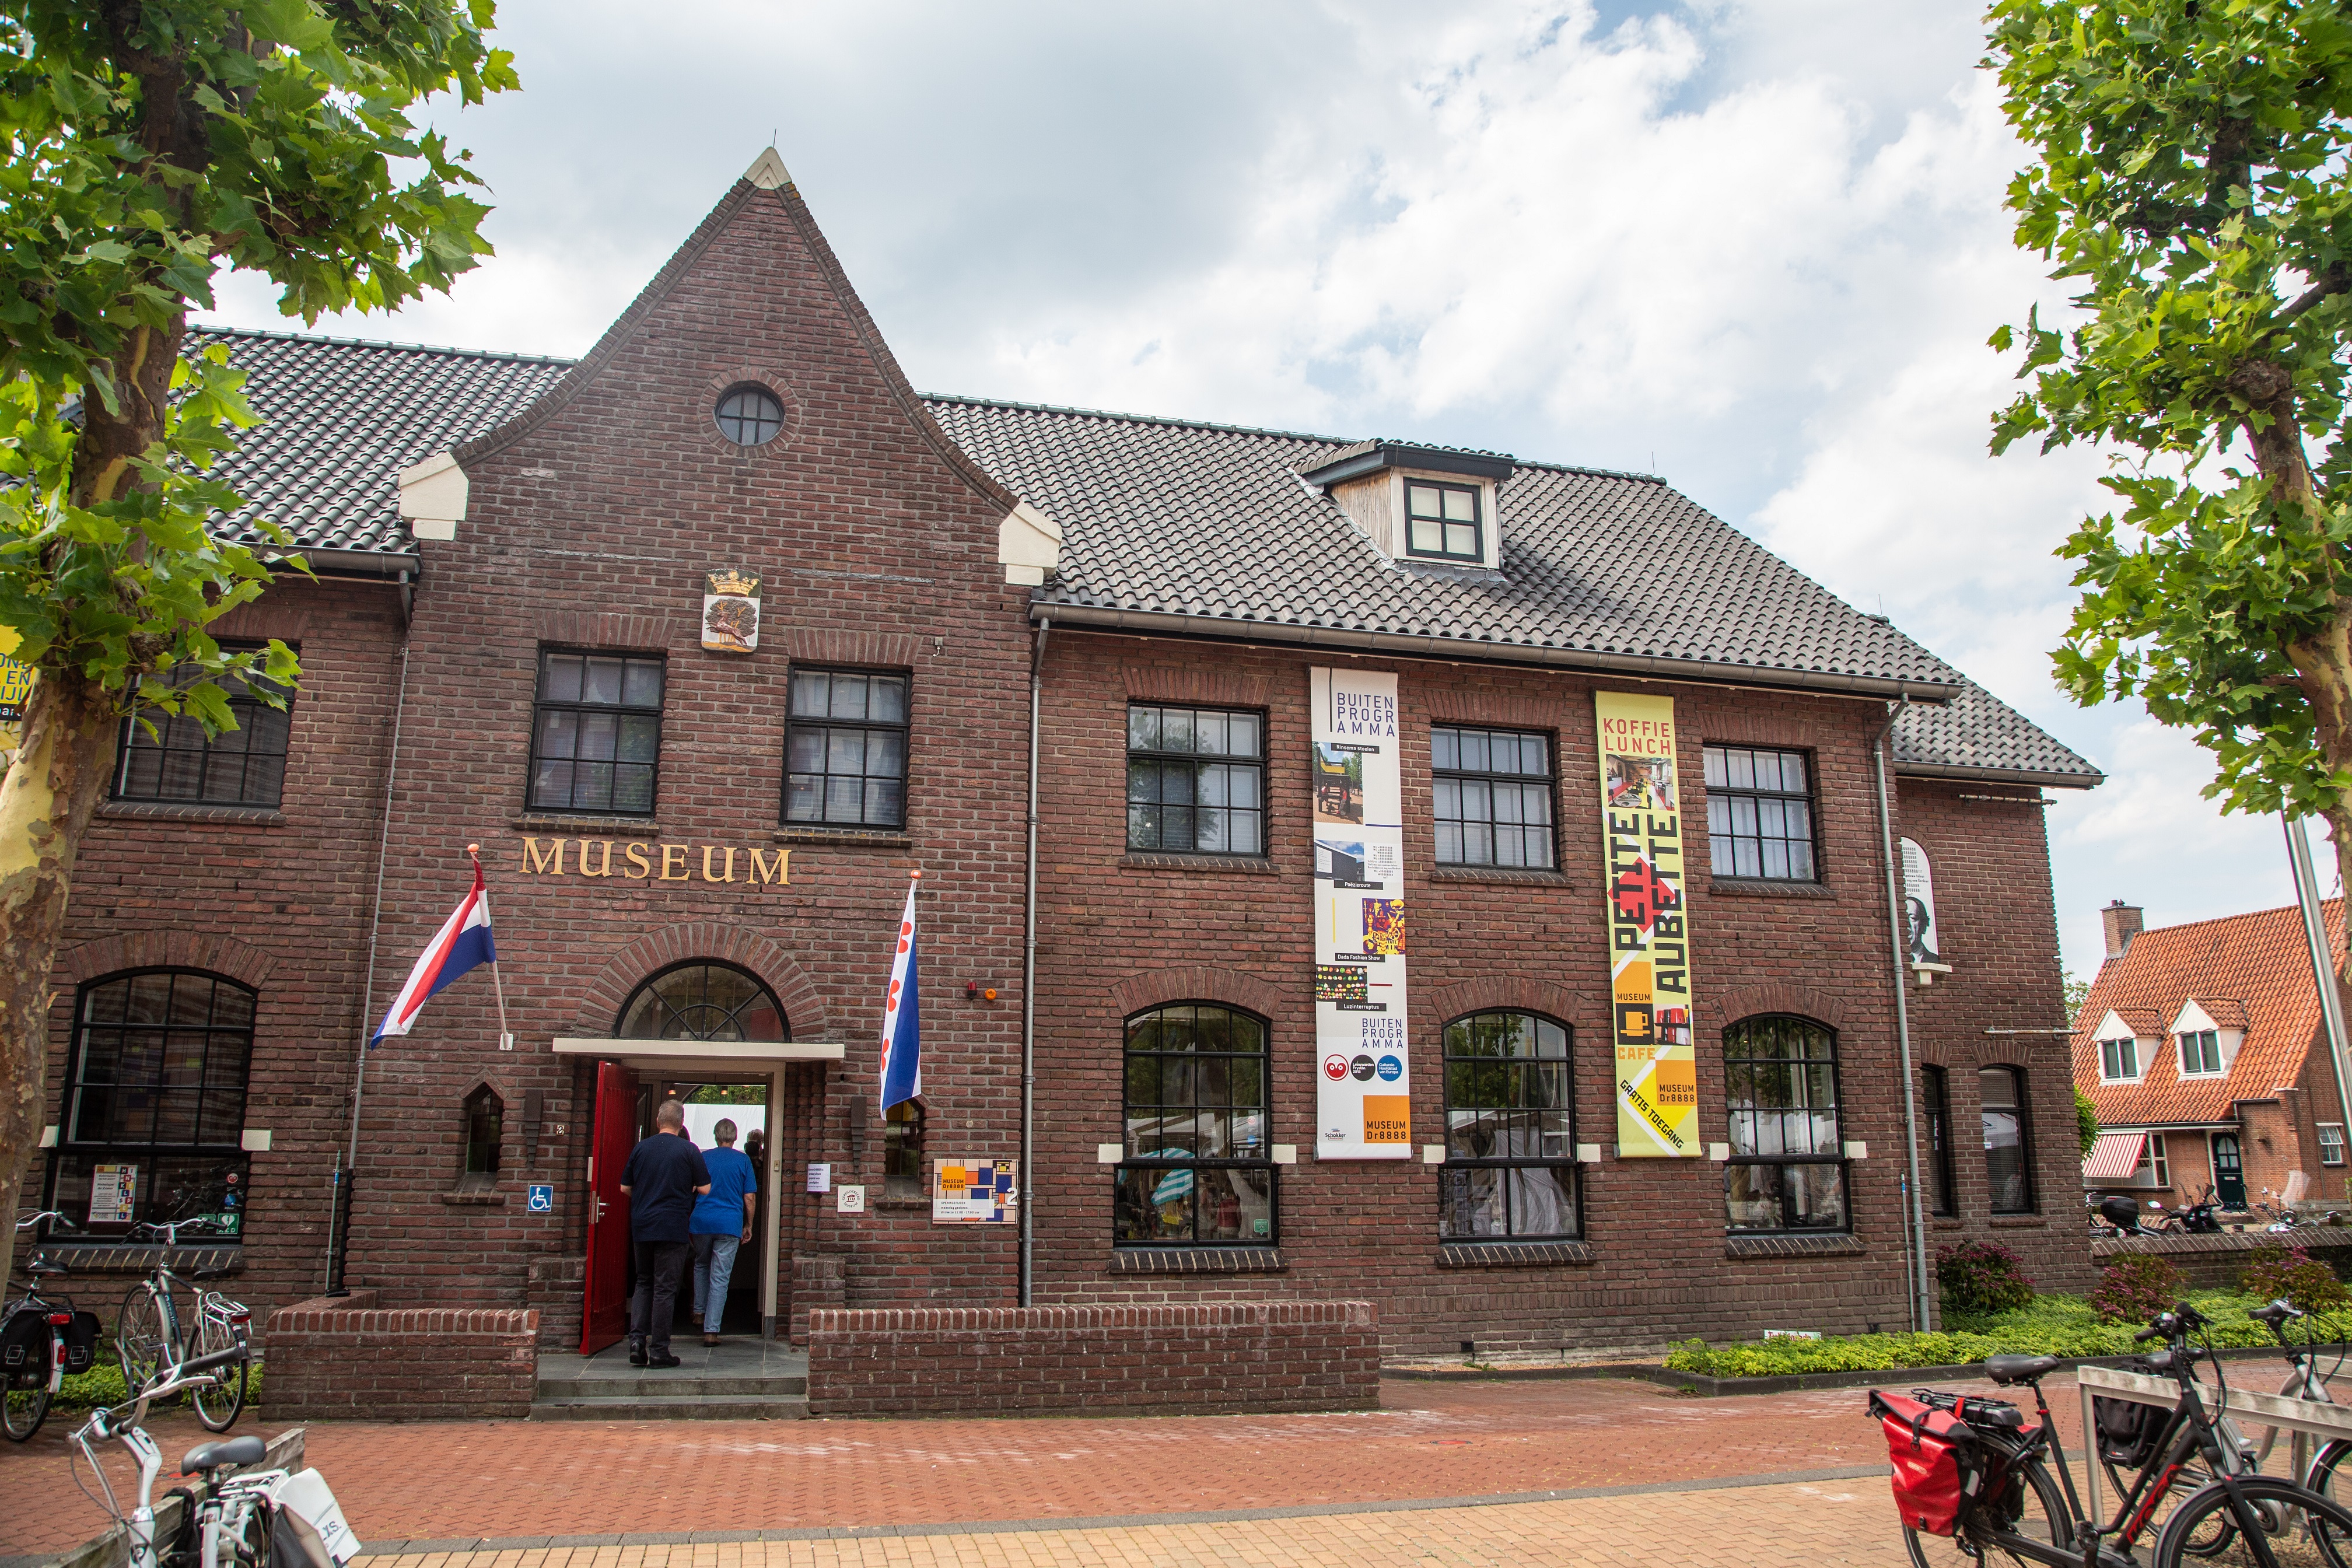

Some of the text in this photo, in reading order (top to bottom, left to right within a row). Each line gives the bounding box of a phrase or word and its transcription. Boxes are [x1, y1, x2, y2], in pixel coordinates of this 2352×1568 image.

[1337, 692, 1393, 709] BUITEN
[1338, 706, 1394, 723] PROGR
[1337, 720, 1395, 737] AMMA
[1603, 718, 1670, 738] KOFFIE
[1605, 736, 1671, 755] LUNCH
[519, 836, 793, 885] MUSEUM
[1608, 812, 1647, 951] PETITE
[1647, 814, 1687, 994] AUBETTE
[1616, 993, 1651, 1001] MUSEUM
[1362, 1018, 1402, 1028] BUITEN
[1362, 1028, 1402, 1038] PROGR
[1362, 1039, 1403, 1048] AMMA
[1618, 1044, 1656, 1060] CAFÉ
[1659, 1084, 1694, 1093] MUSEUM
[1660, 1094, 1695, 1102] Dr8888
[1620, 1079, 1685, 1149] GRATIS TOEGANG
[1367, 1121, 1406, 1129] MUSEUM
[1367, 1131, 1406, 1140] Dr8888
